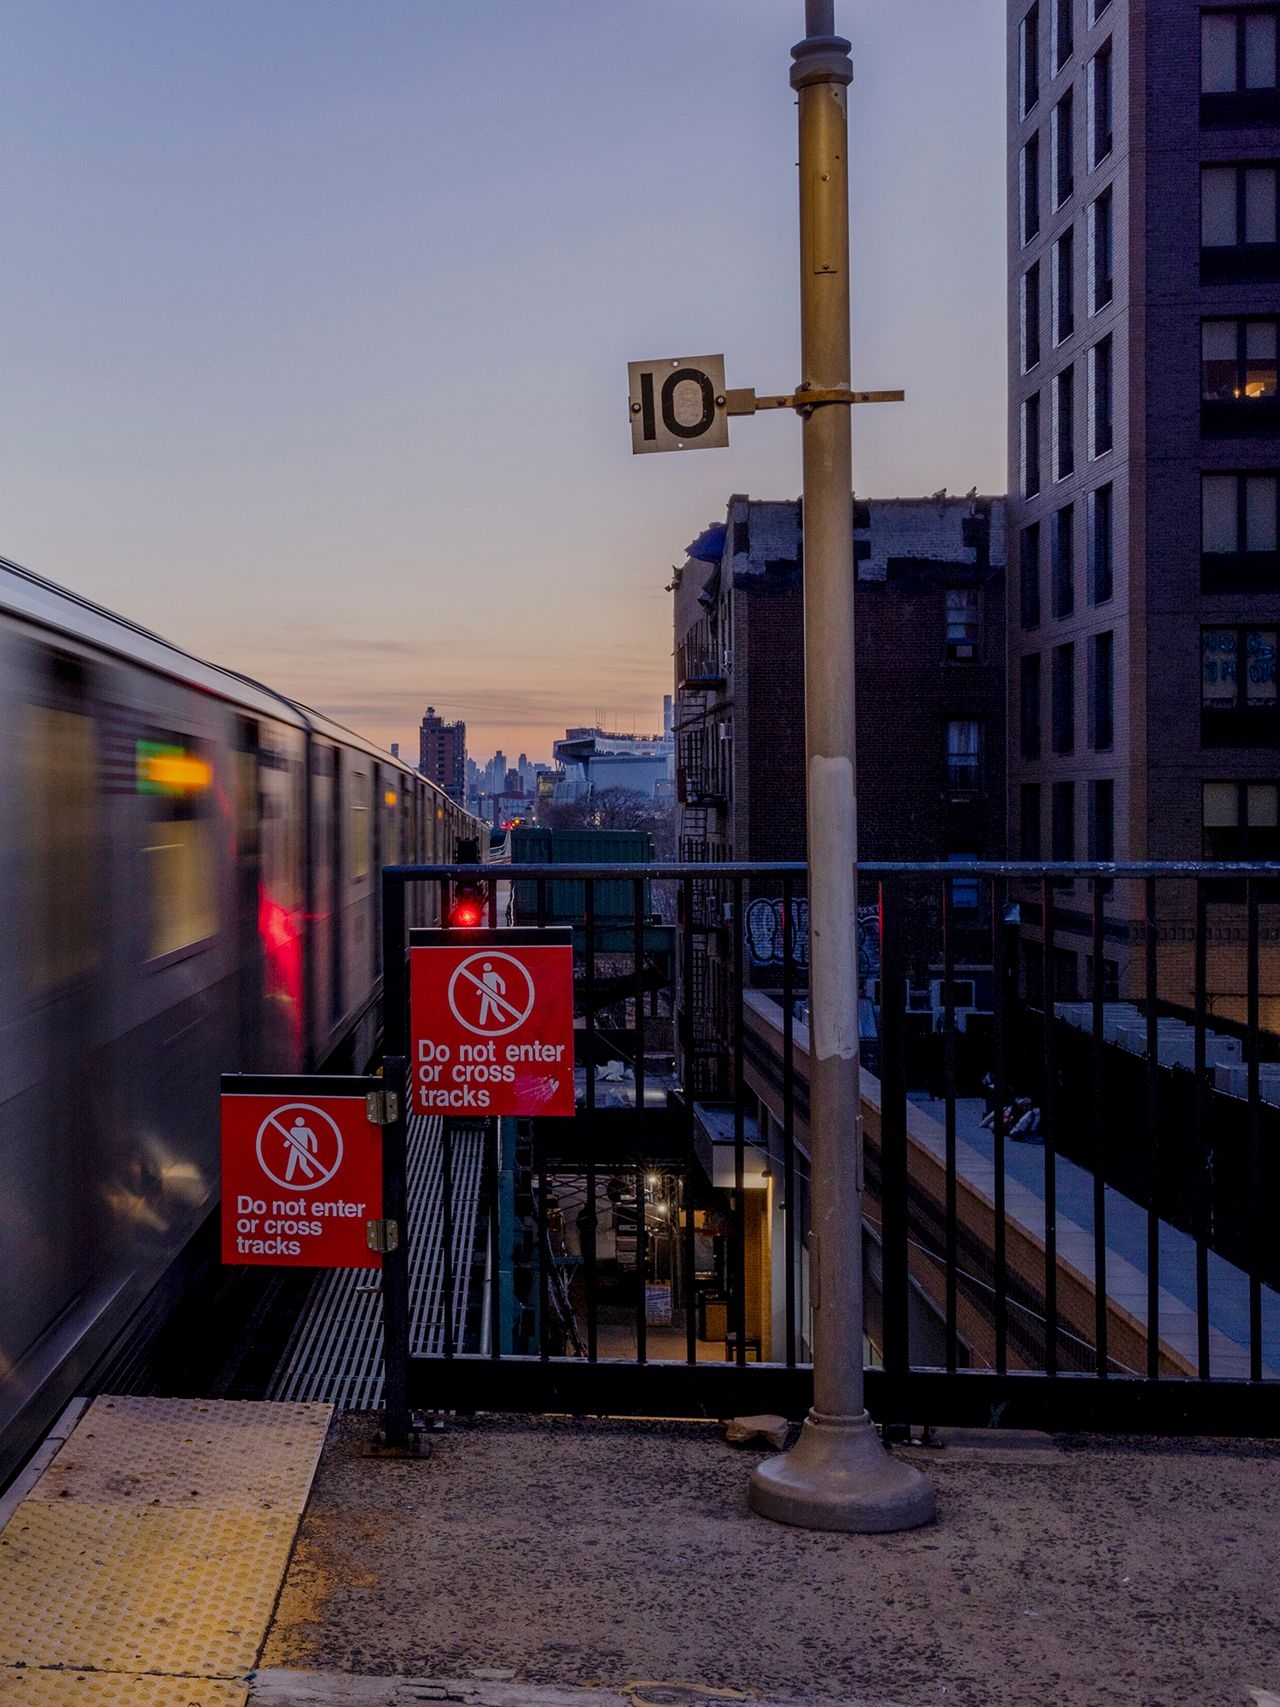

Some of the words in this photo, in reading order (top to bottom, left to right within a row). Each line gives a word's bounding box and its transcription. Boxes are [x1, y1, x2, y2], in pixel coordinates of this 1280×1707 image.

[640, 368, 715, 440] 10
[418, 1039, 450, 1062] Do
[459, 1040, 496, 1062] not
[505, 1040, 565, 1062] enter
[419, 1064, 442, 1082] or
[451, 1064, 516, 1082] cross
[419, 1084, 491, 1107] tracks
[237, 1195, 267, 1215] Do
[272, 1198, 307, 1216] not
[310, 1199, 366, 1218] enter
[236, 1218, 259, 1233] or
[263, 1219, 323, 1236] cross
[236, 1235, 301, 1255] tracks
